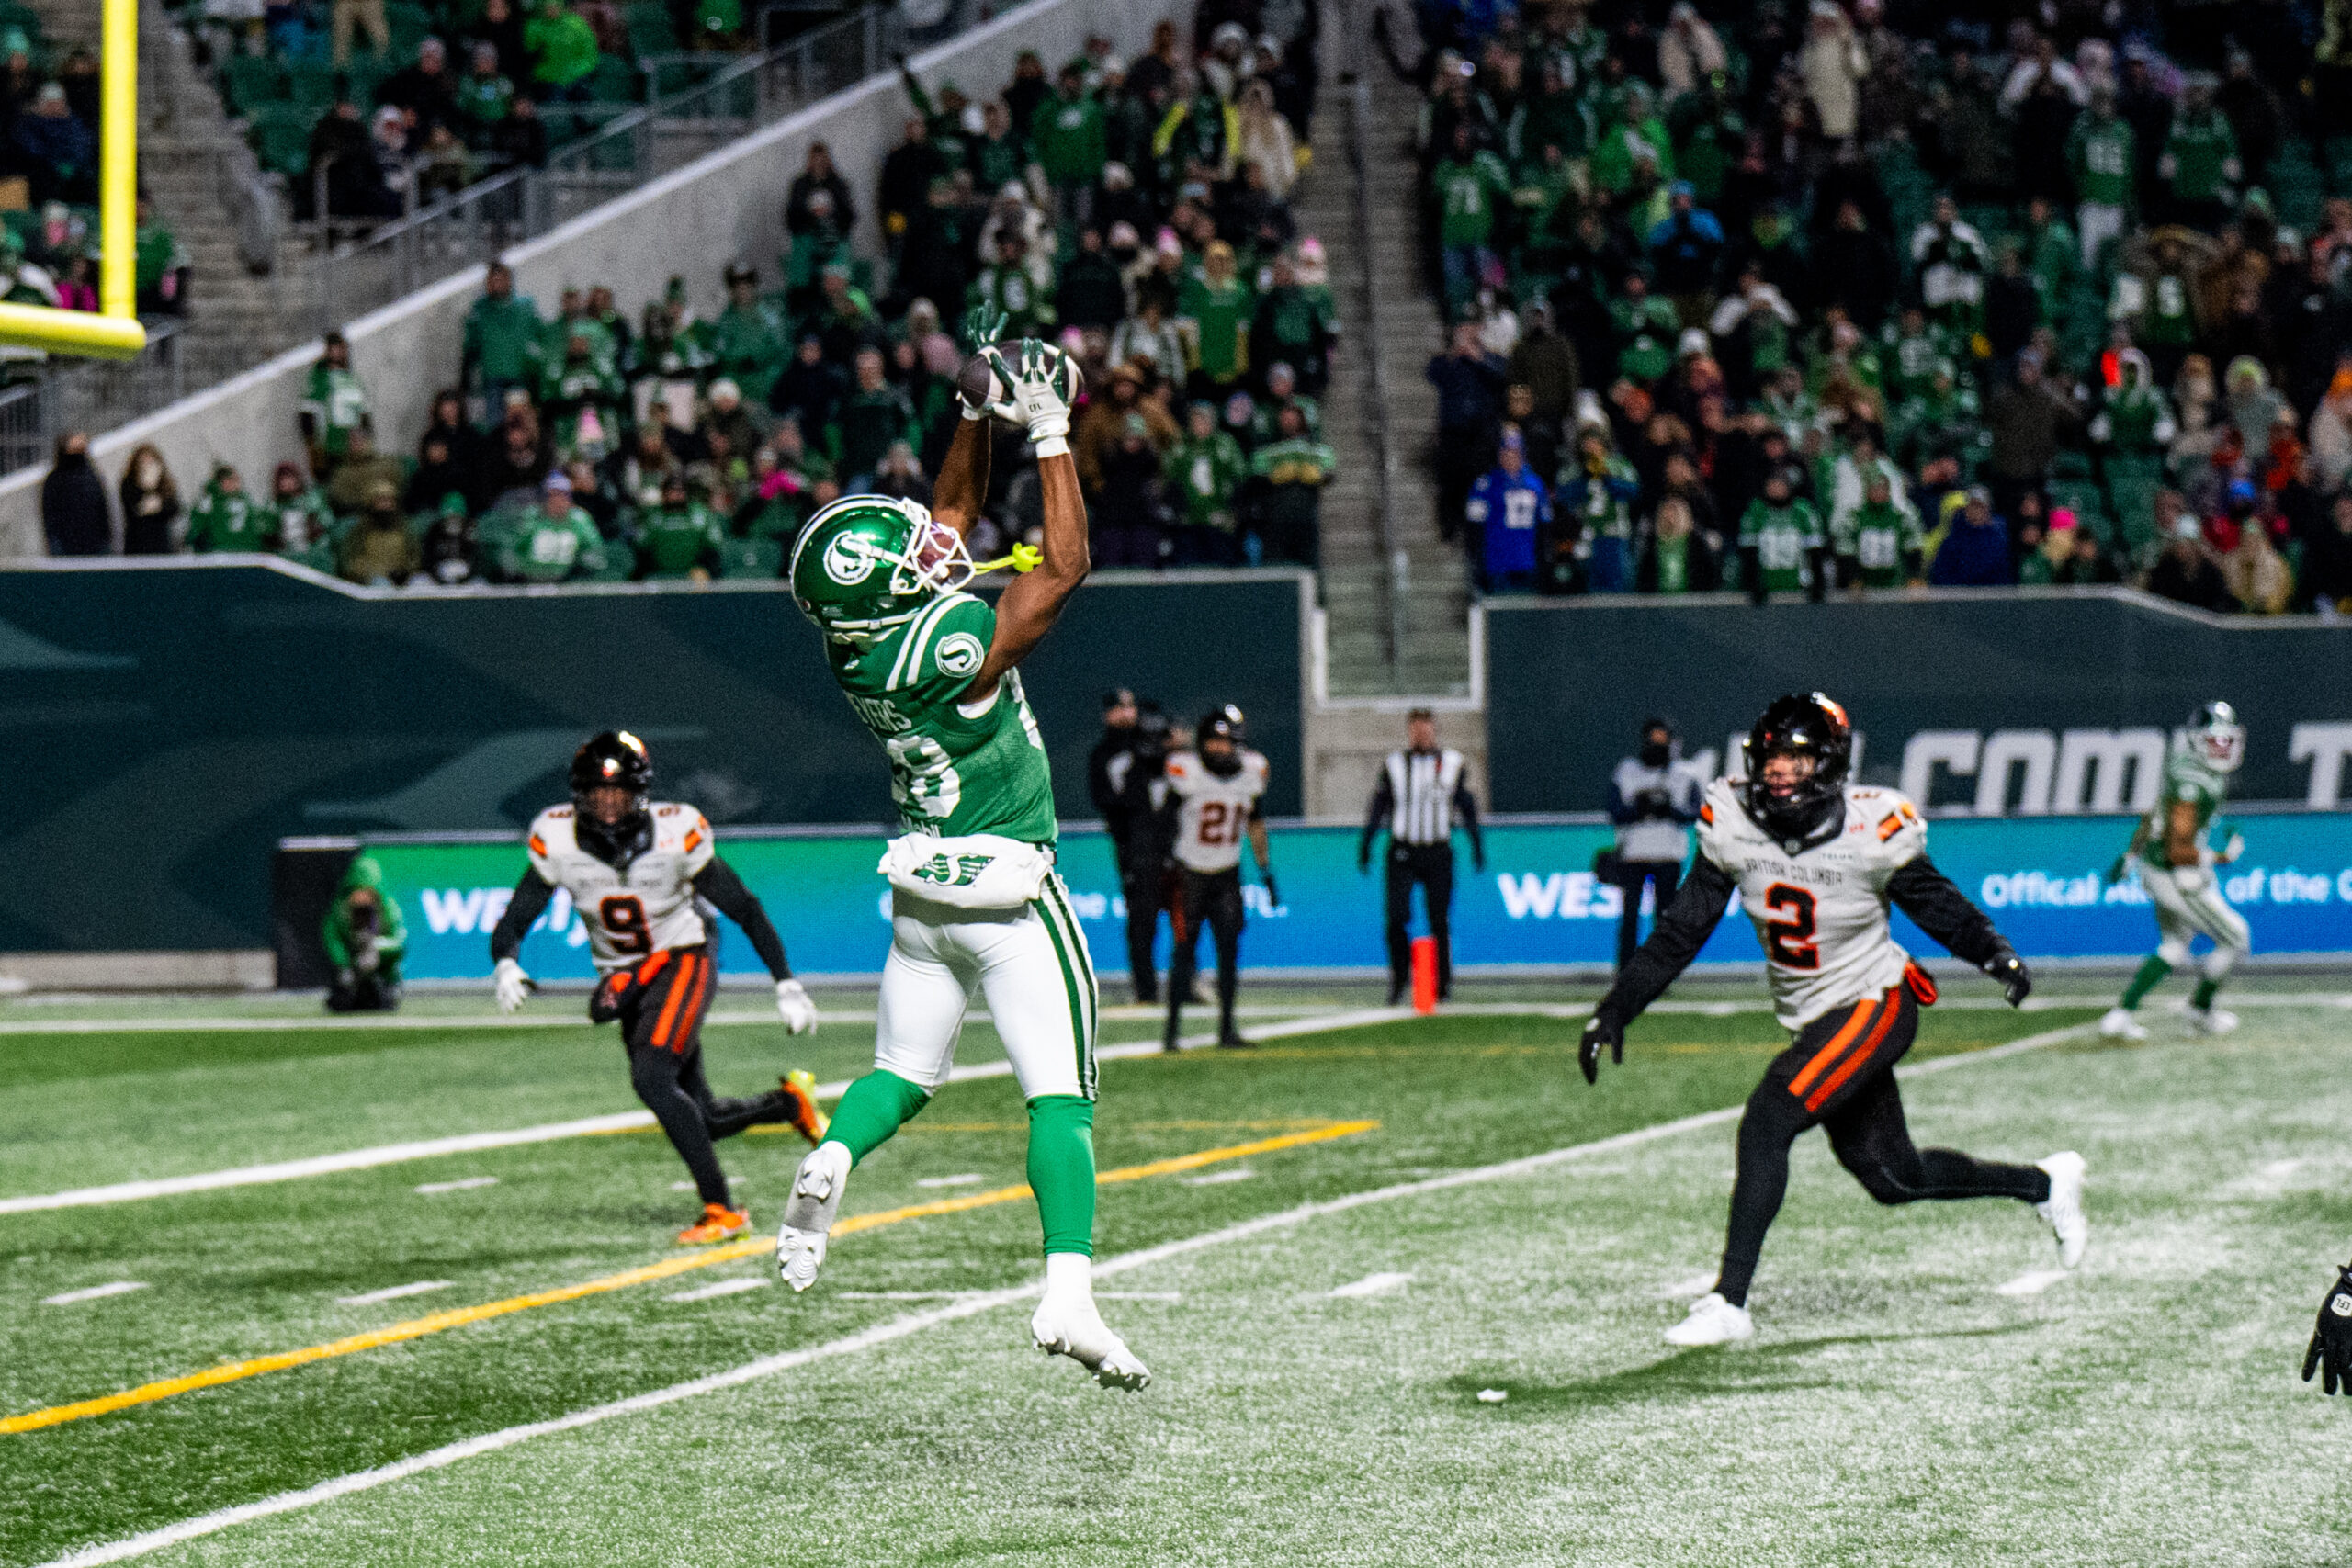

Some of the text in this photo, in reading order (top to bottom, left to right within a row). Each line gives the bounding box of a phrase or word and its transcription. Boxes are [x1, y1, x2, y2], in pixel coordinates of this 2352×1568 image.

[1198, 800, 1243, 845] 21
[1744, 858, 1843, 886] BRITISH COLUMBIA
[600, 895, 653, 953] 9
[1764, 882, 1821, 970] 2
